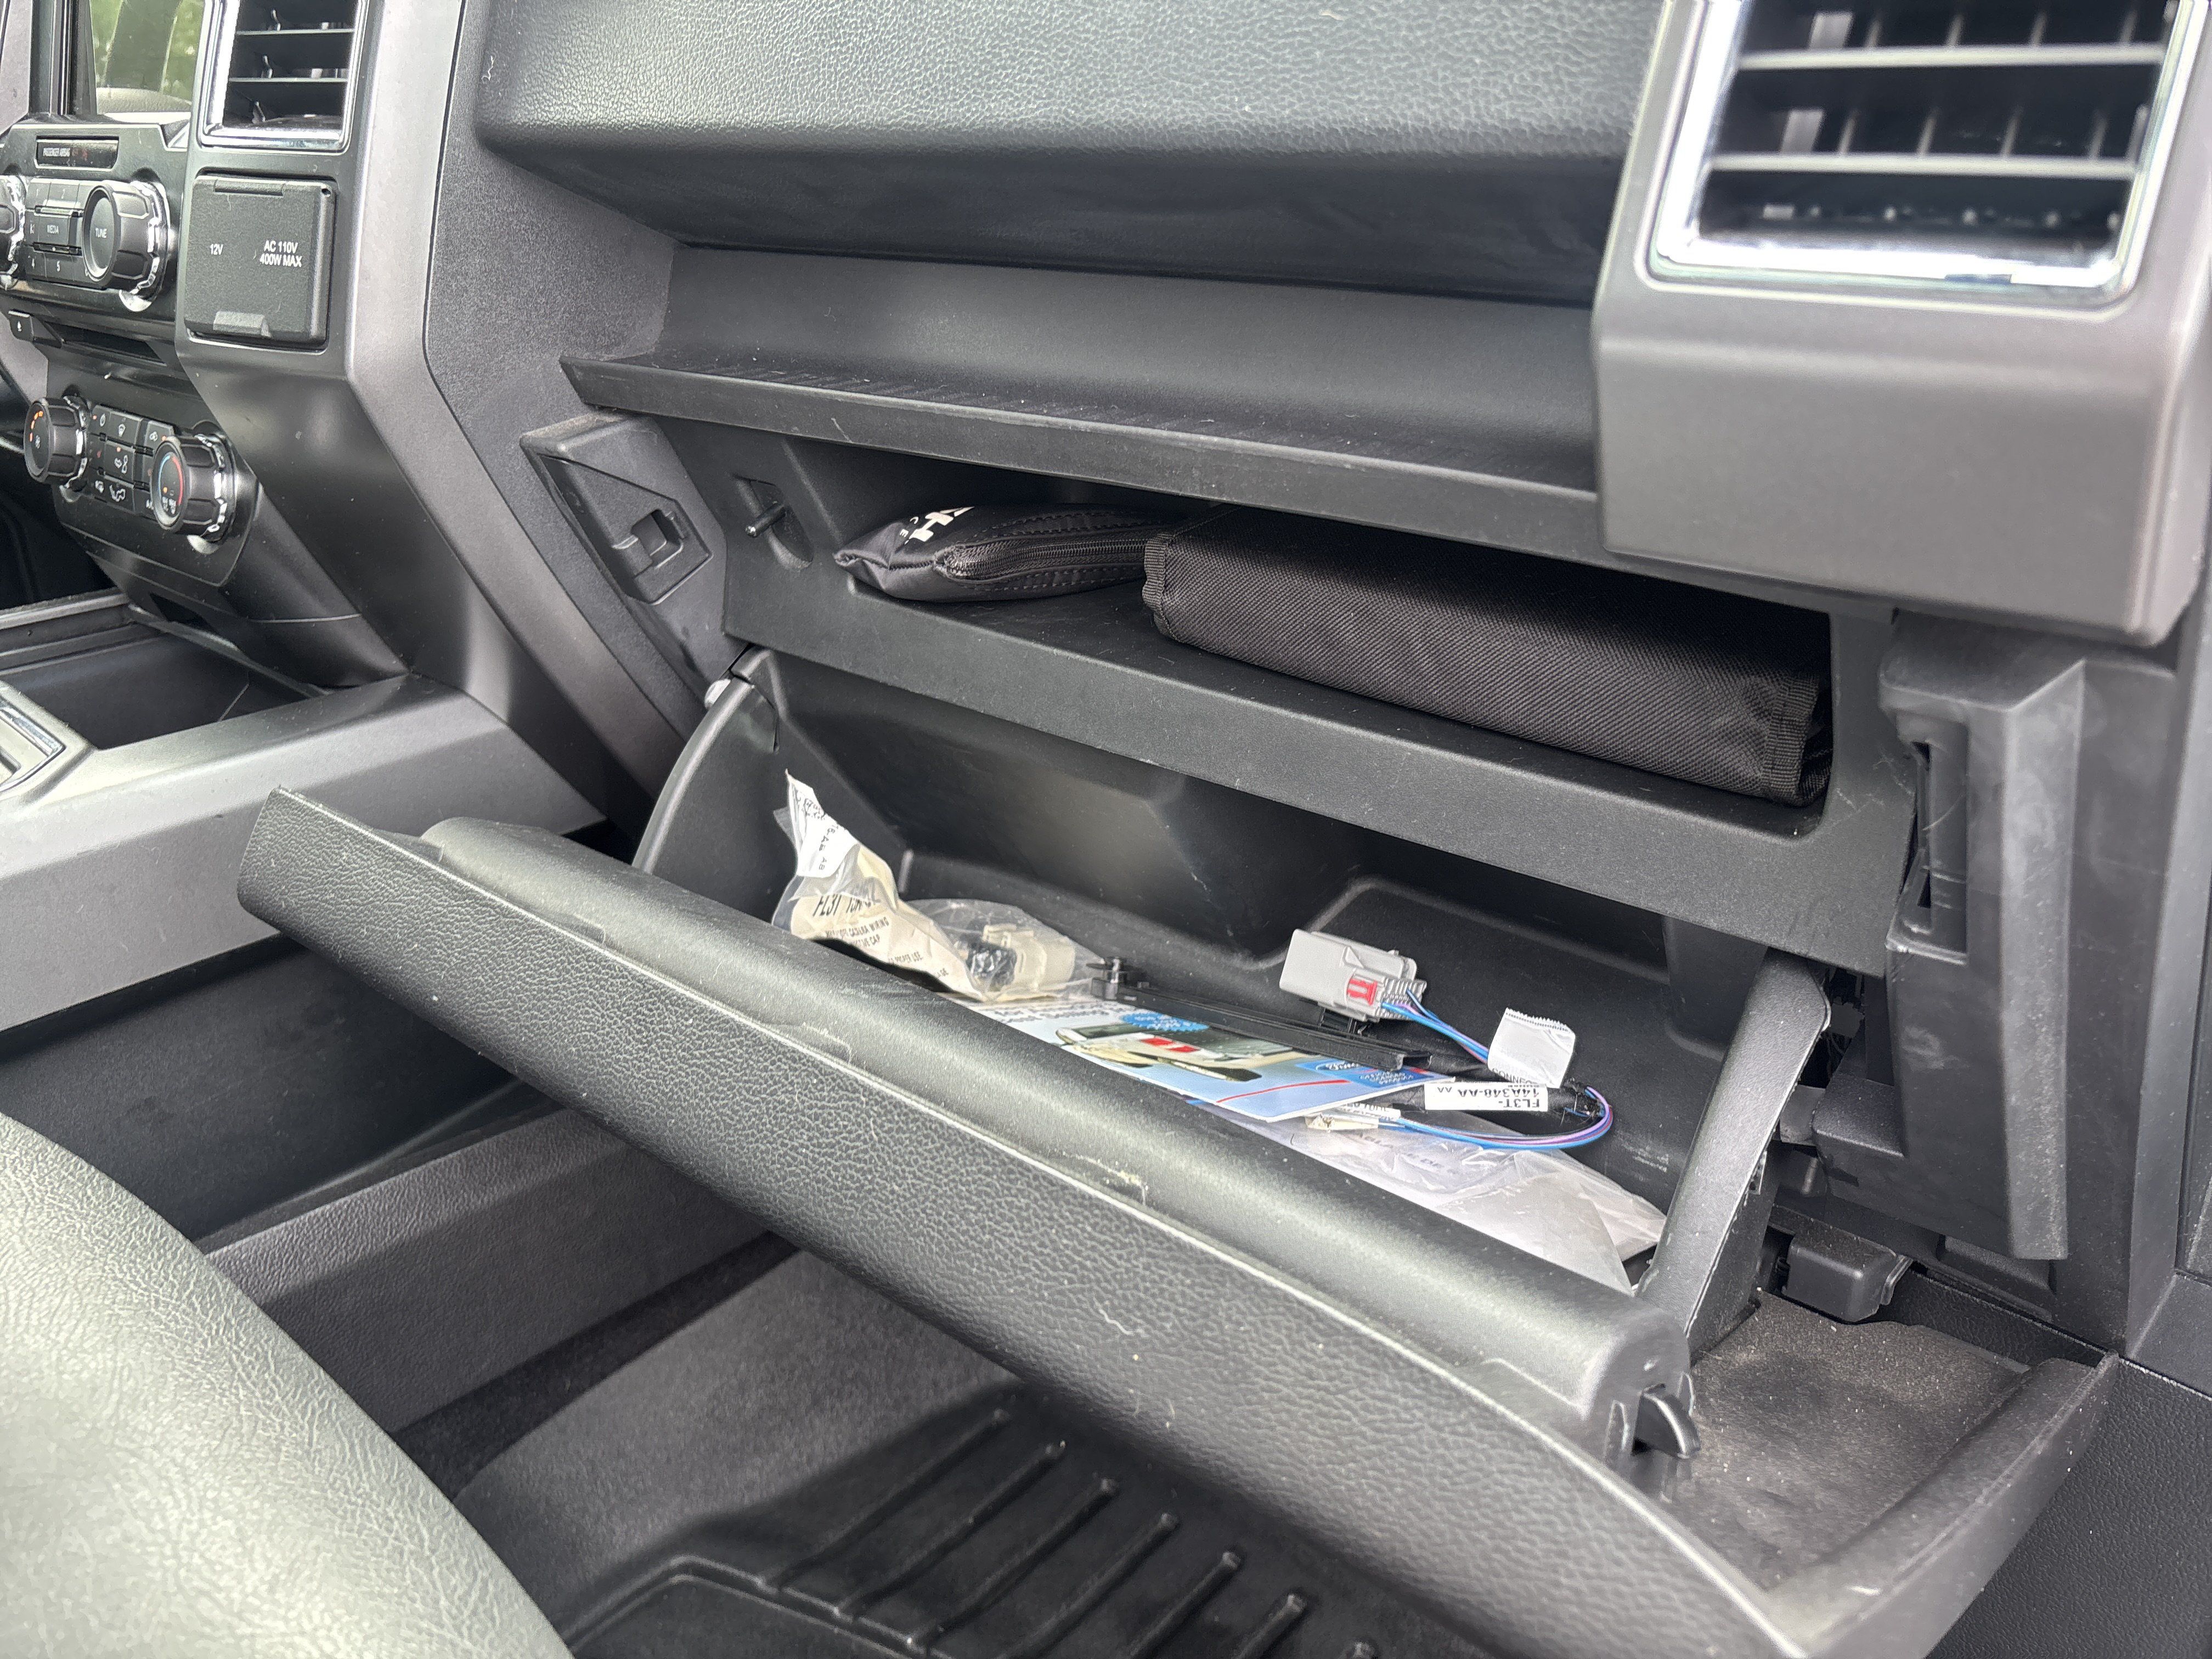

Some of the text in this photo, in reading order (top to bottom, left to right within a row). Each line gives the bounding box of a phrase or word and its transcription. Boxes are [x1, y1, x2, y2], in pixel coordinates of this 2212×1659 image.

[95, 228, 108, 239] TUNE
[210, 244, 224, 255] 12V
[264, 240, 298, 254] AC 110V
[259, 253, 302, 268] 400W MAX
[1498, 1098, 1540, 1108] FL3T-
